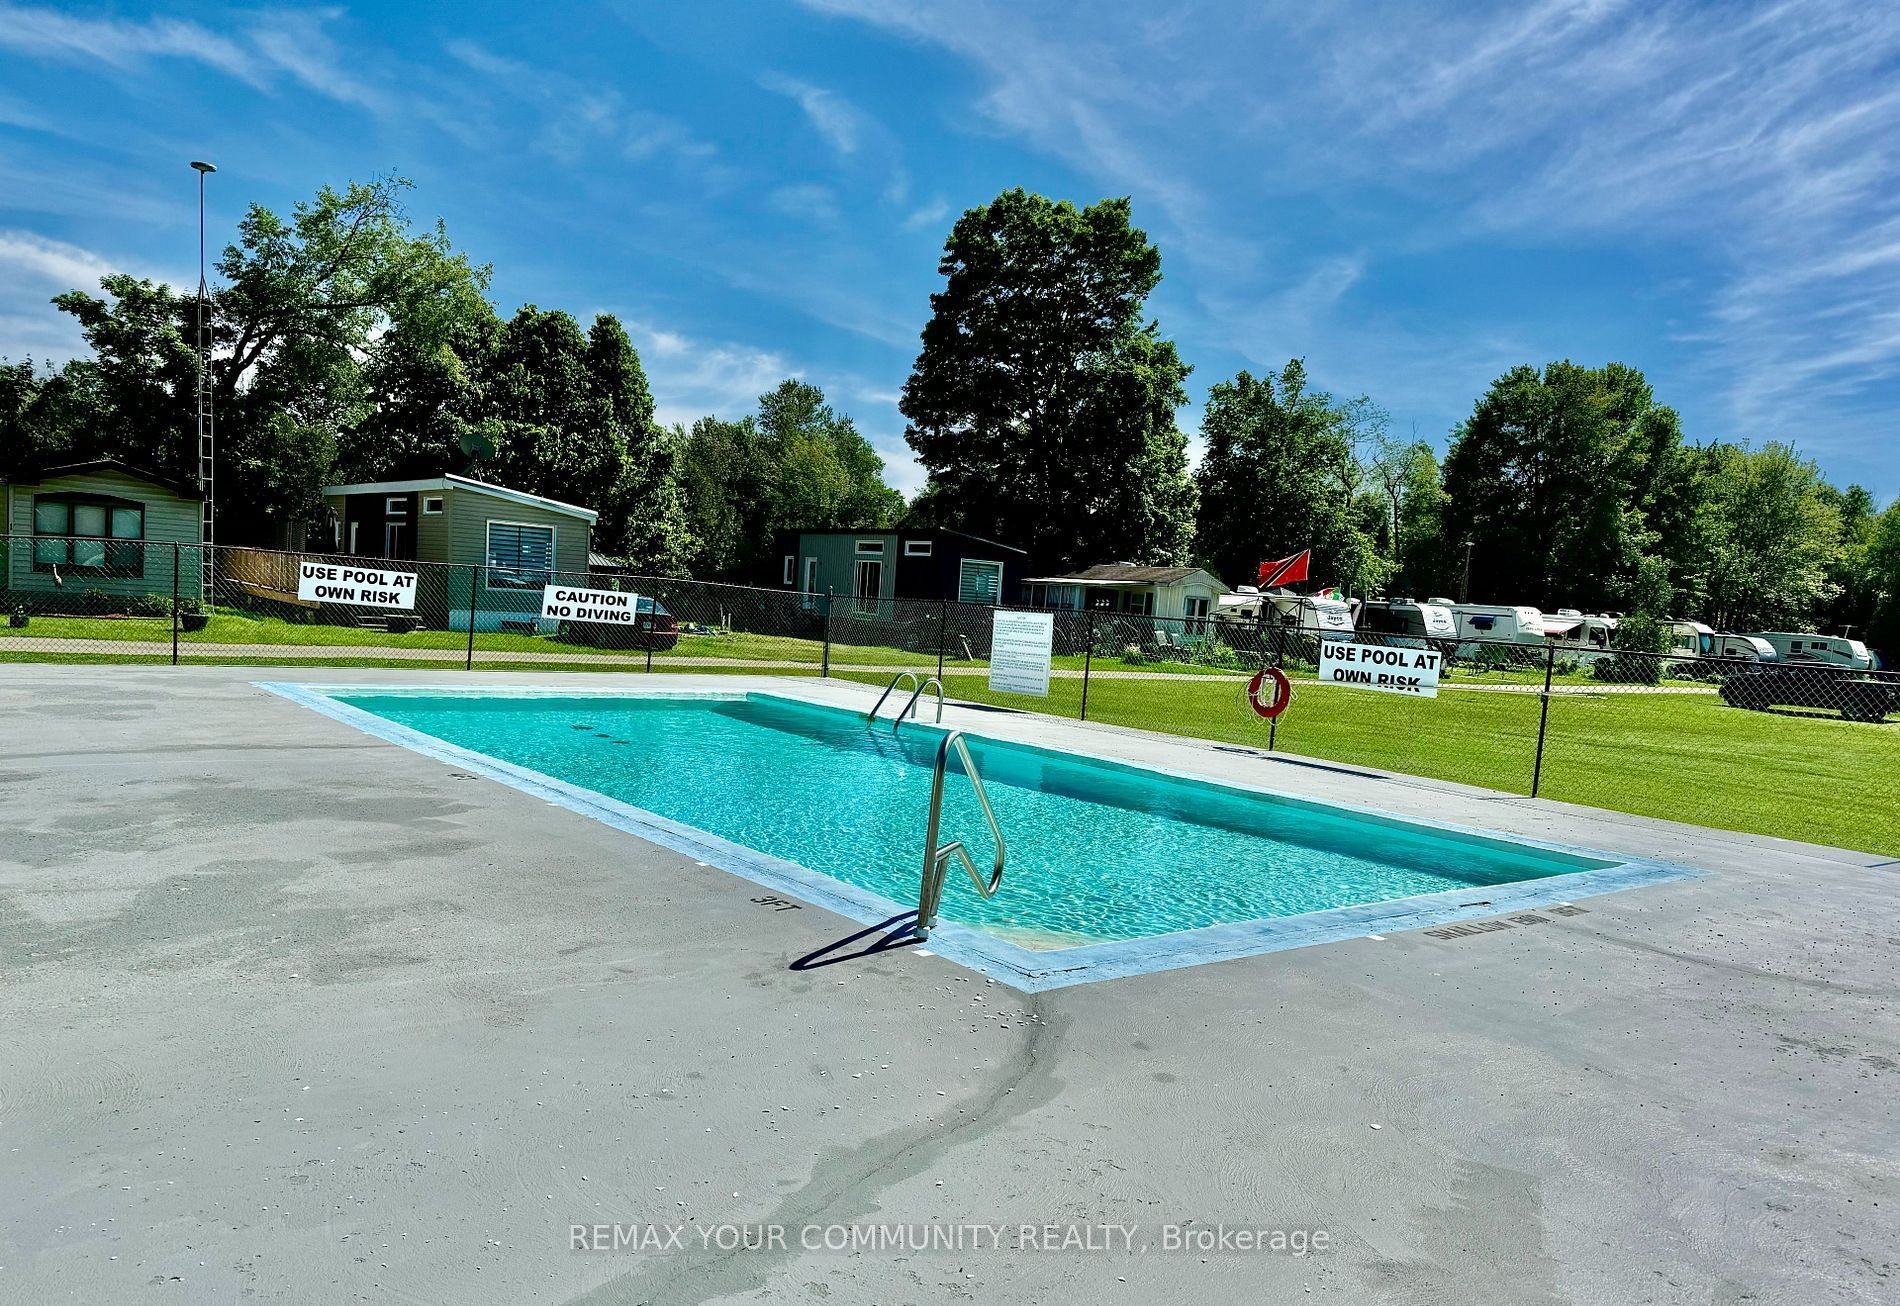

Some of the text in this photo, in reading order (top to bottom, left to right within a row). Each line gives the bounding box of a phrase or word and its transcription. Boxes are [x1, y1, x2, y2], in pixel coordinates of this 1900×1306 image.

[303, 565, 414, 588] USE POOL AT
[315, 585, 400, 604] OWN RISK
[556, 590, 627, 606] CAUTION
[547, 605, 631, 621] NO DIVING
[1324, 645, 1438, 670] USE POOL AT
[1333, 668, 1420, 692] OWN RISK
[750, 896, 803, 911] 3FT
